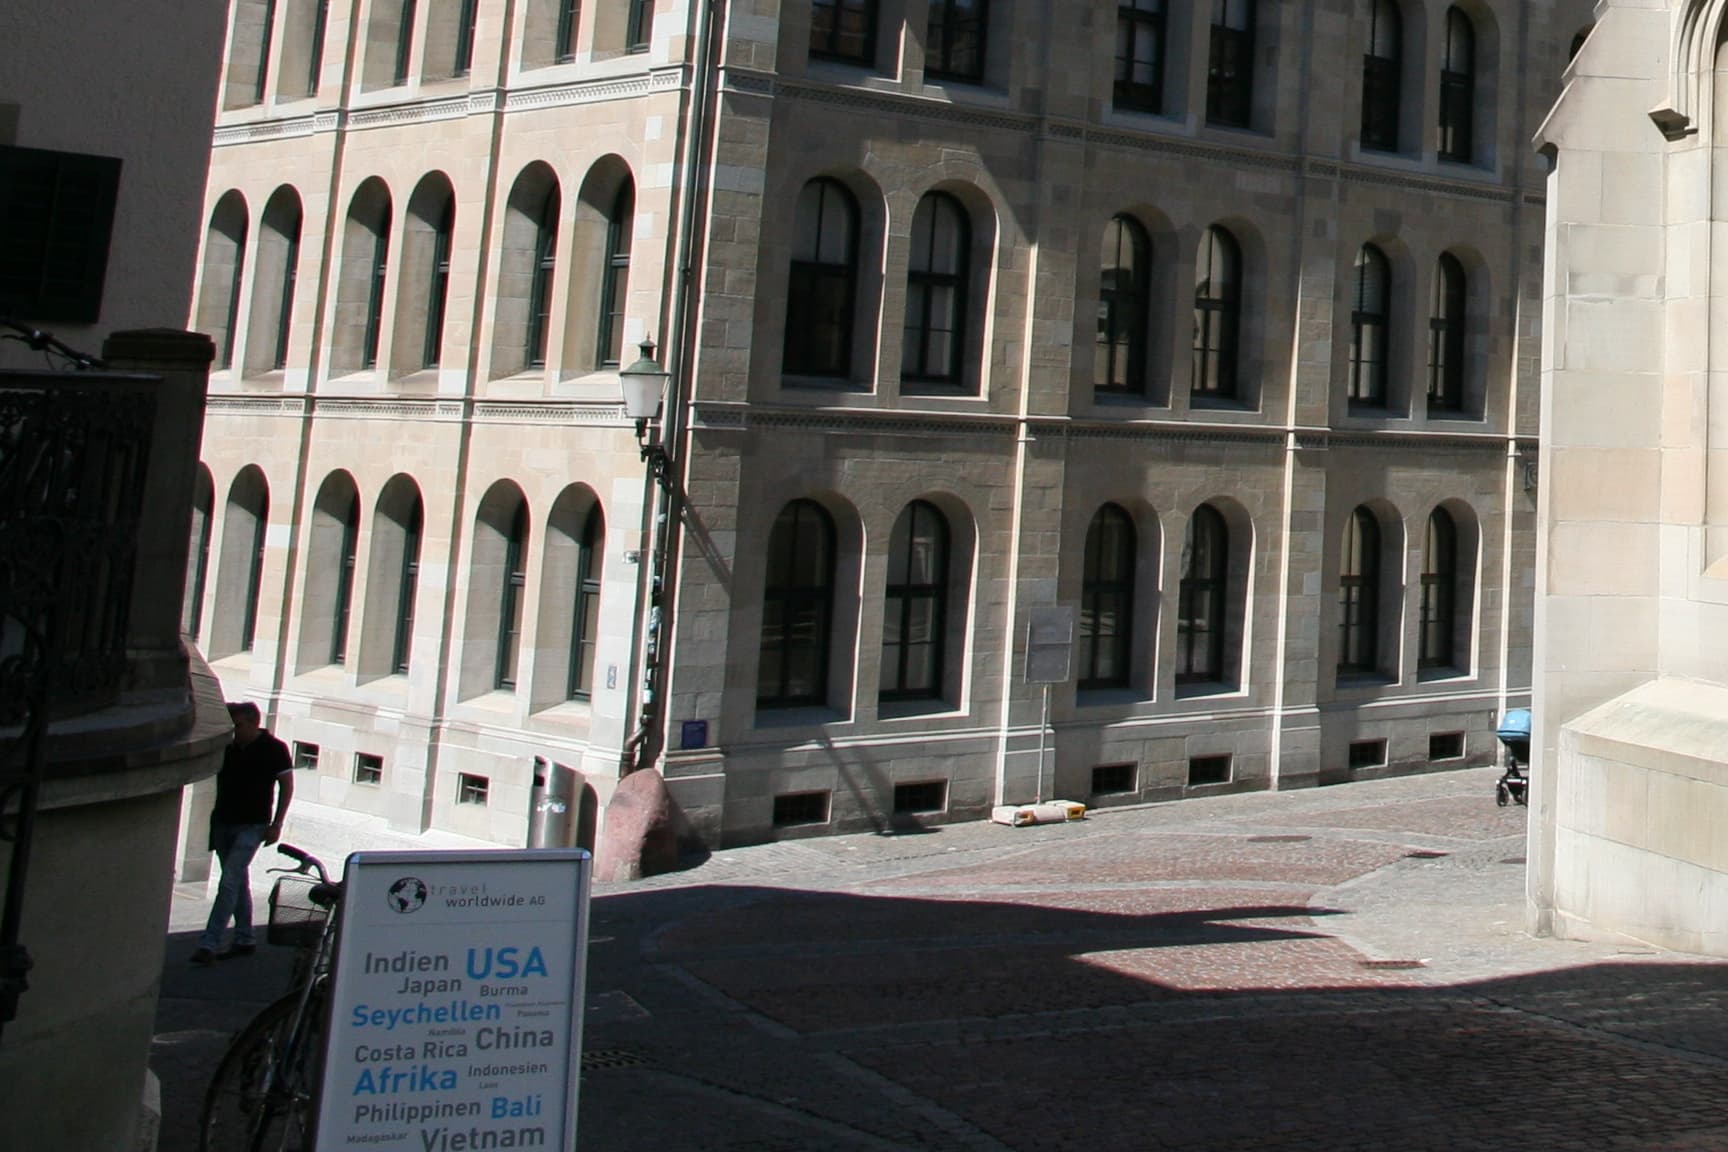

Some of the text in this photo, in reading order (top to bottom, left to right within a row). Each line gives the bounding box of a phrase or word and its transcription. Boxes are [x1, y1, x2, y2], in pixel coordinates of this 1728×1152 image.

[431, 883, 487, 895] travel
[446, 896, 545, 907] worldwide AG
[365, 946, 548, 980] Indien USA
[397, 977, 528, 997] Japan Burma
[352, 1000, 500, 1030] Seychellen
[476, 1026, 554, 1050] China
[355, 1041, 468, 1063] Costa Rica
[353, 1064, 457, 1096] Afrika
[468, 1062, 548, 1077] Indonesien
[354, 1095, 541, 1124] Philippinen Bali
[421, 1127, 545, 1152] Vietnam
